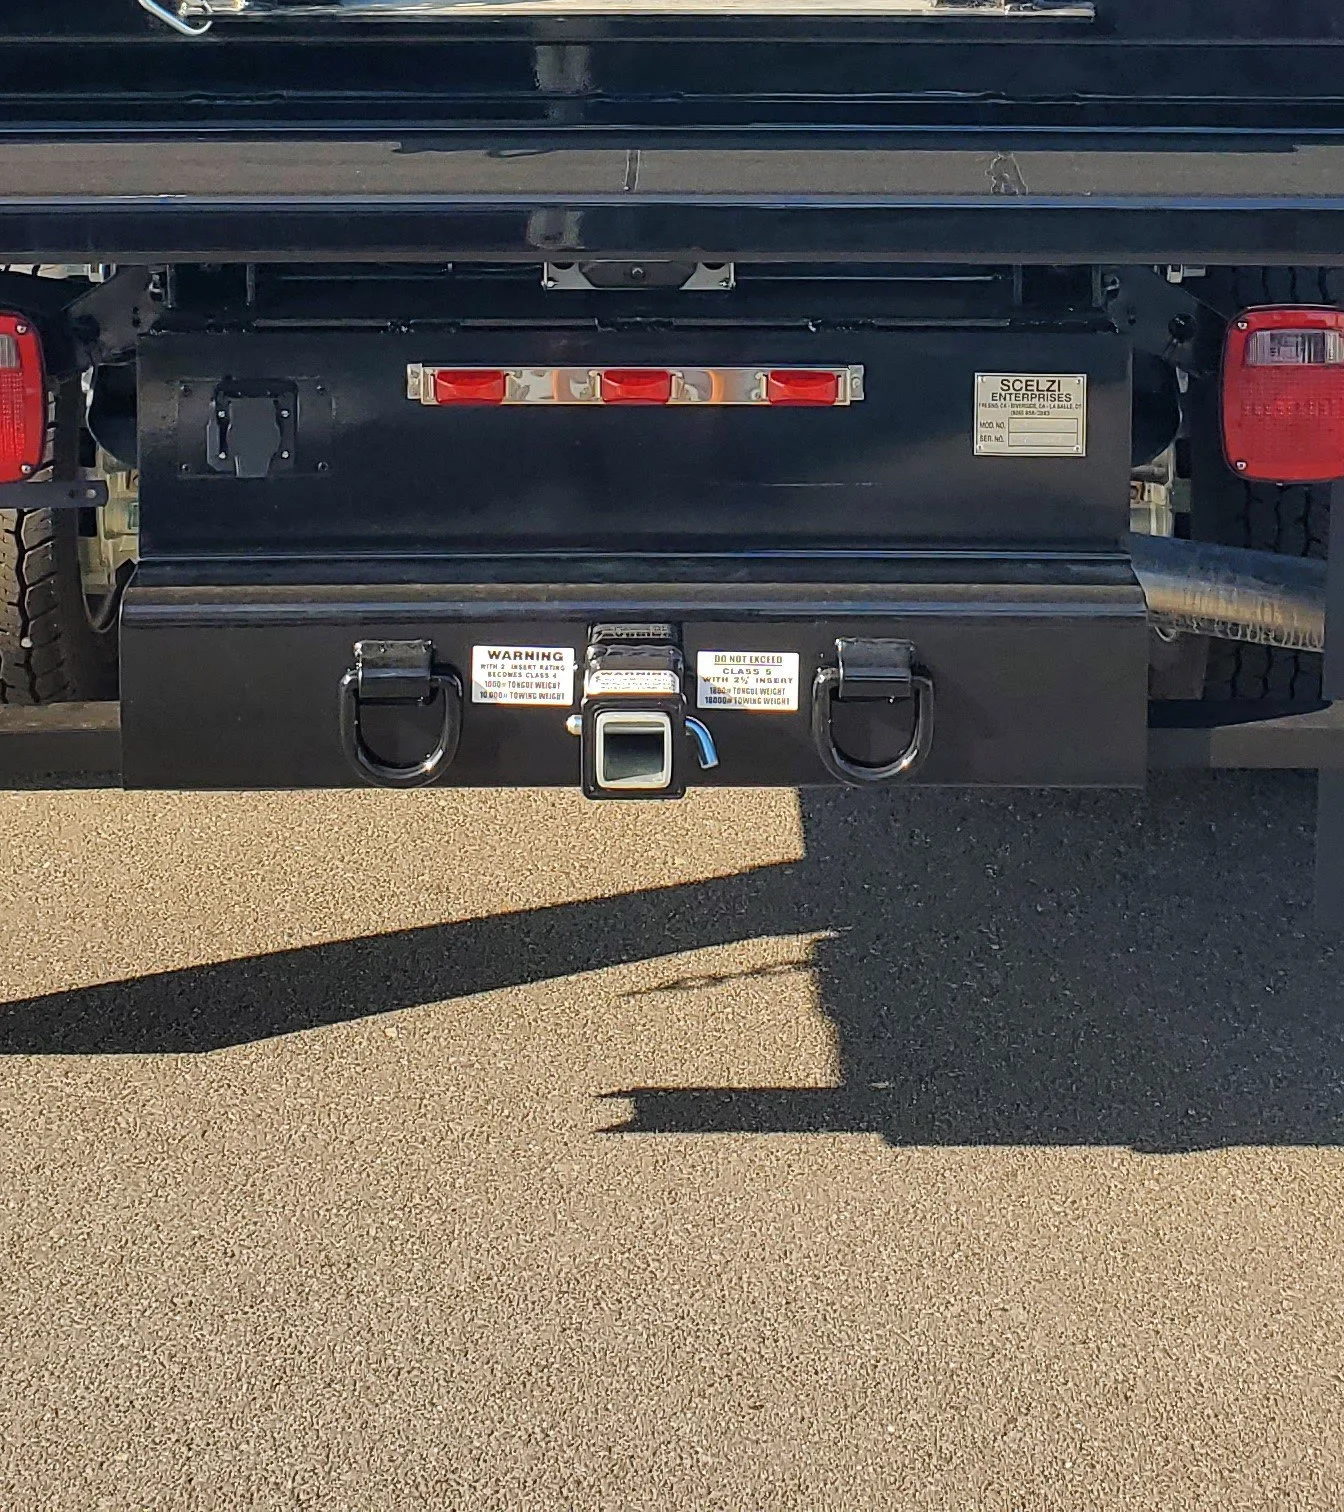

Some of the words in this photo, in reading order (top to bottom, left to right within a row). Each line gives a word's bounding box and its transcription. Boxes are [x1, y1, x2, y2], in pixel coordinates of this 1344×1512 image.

[1000, 379, 1061, 392] SCELZI
[991, 392, 1072, 403] ENTERPRISES
[487, 650, 564, 661] WARNING
[714, 655, 727, 663] DO
[729, 655, 747, 663] NOT
[749, 656, 783, 664] EXCEED
[535, 681, 560, 689] WEIGHT
[510, 691, 537, 700] TOWING
[538, 692, 564, 700] WEIGHT
[759, 688, 785, 696] WEIGHT
[734, 697, 762, 705] TOWING
[763, 697, 790, 705] WEIGHT
